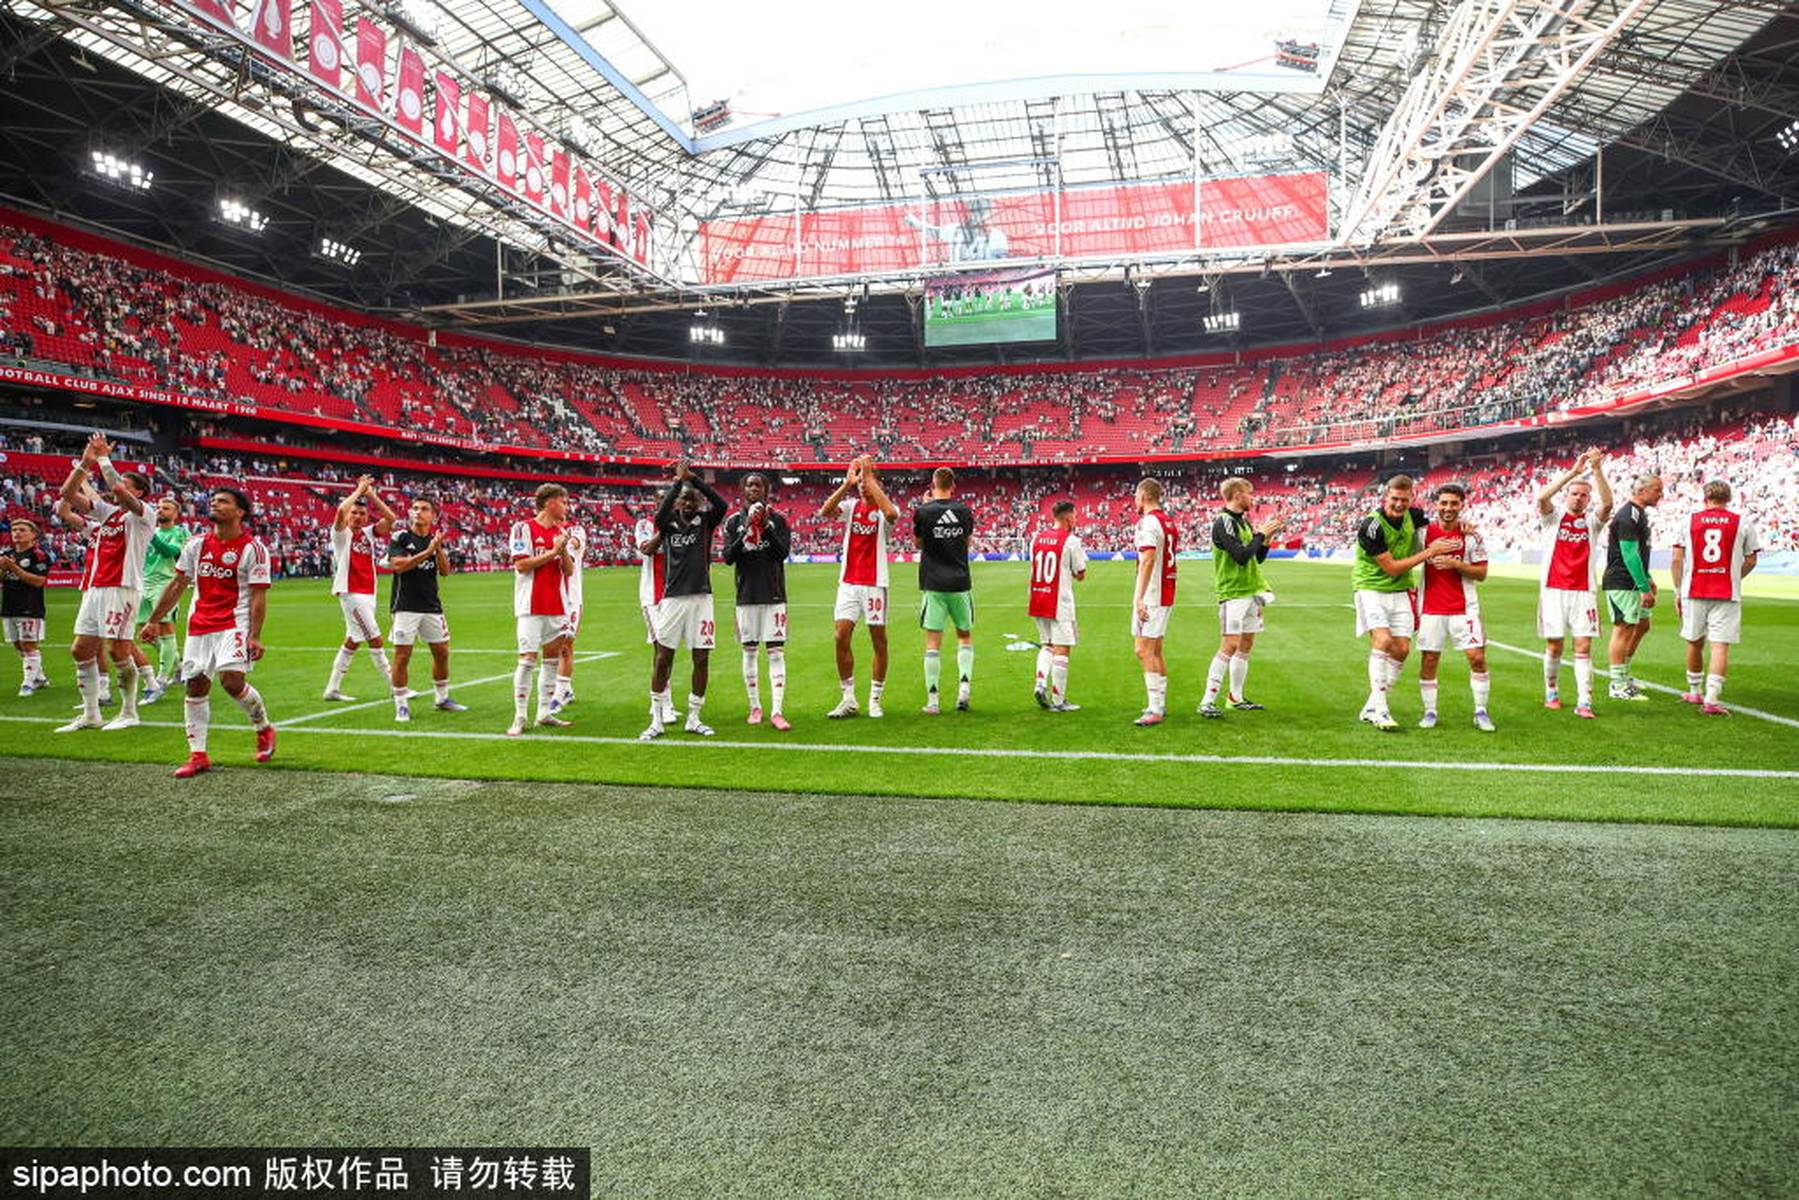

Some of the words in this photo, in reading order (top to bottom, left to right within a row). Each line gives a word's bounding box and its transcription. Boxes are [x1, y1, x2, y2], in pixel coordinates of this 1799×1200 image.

[1151, 211, 1214, 227] JOHAN
[64, 378, 98, 391] CLUB
[101, 384, 135, 397] AJAX
[139, 389, 172, 403] SINDS
[192, 398, 229, 411] MAART
[1702, 528, 1723, 563] 8
[1034, 550, 1057, 584] 10
[868, 598, 882, 611] 30
[105, 610, 122, 626] 25
[22, 621, 34, 632] 17
[700, 620, 715, 636] 20
[1466, 620, 1474, 634] 7
[234, 631, 244, 649] 5
